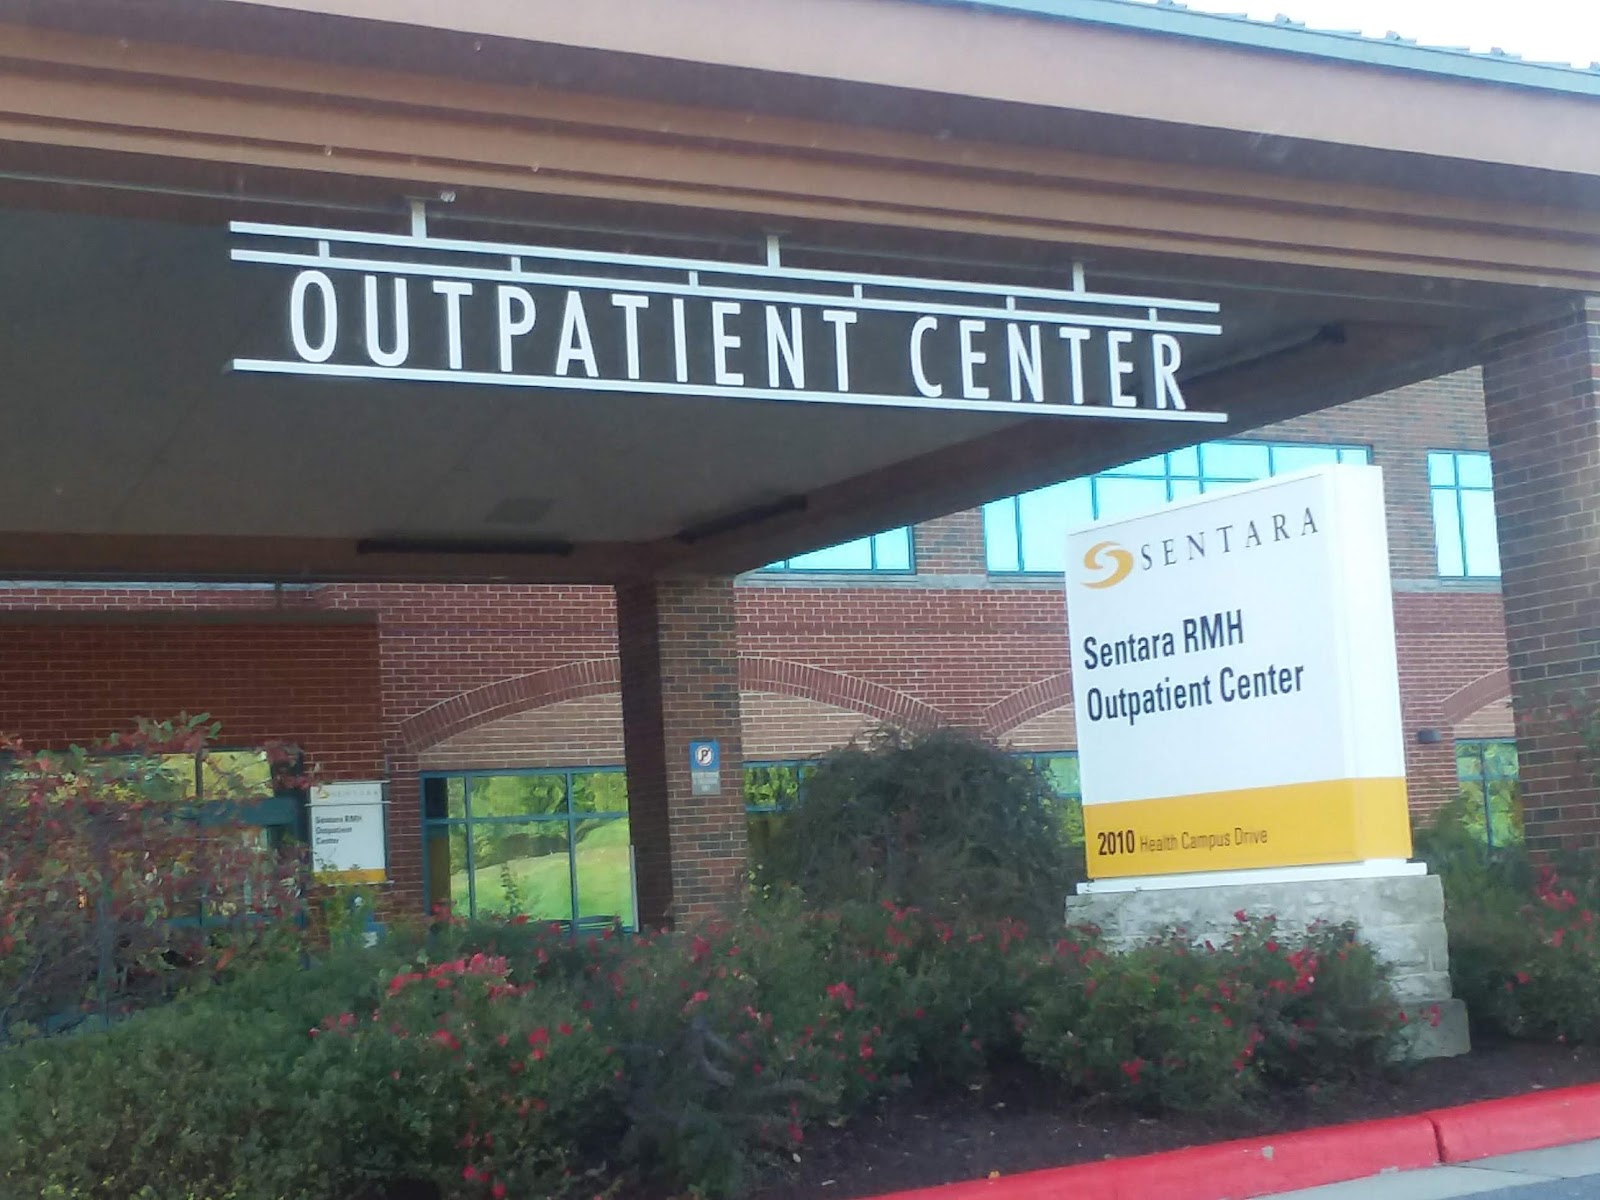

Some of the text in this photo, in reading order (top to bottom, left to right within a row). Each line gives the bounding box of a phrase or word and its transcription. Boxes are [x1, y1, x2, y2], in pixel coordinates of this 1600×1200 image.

[289, 269, 1187, 410] OUTPATIENT CENTER
[1140, 506, 1319, 571] SENTARA
[1083, 608, 1245, 670] Sentara RMH
[1086, 664, 1304, 726] Outpatient Center
[1097, 827, 1268, 856] 2010 Health Campus Drive
